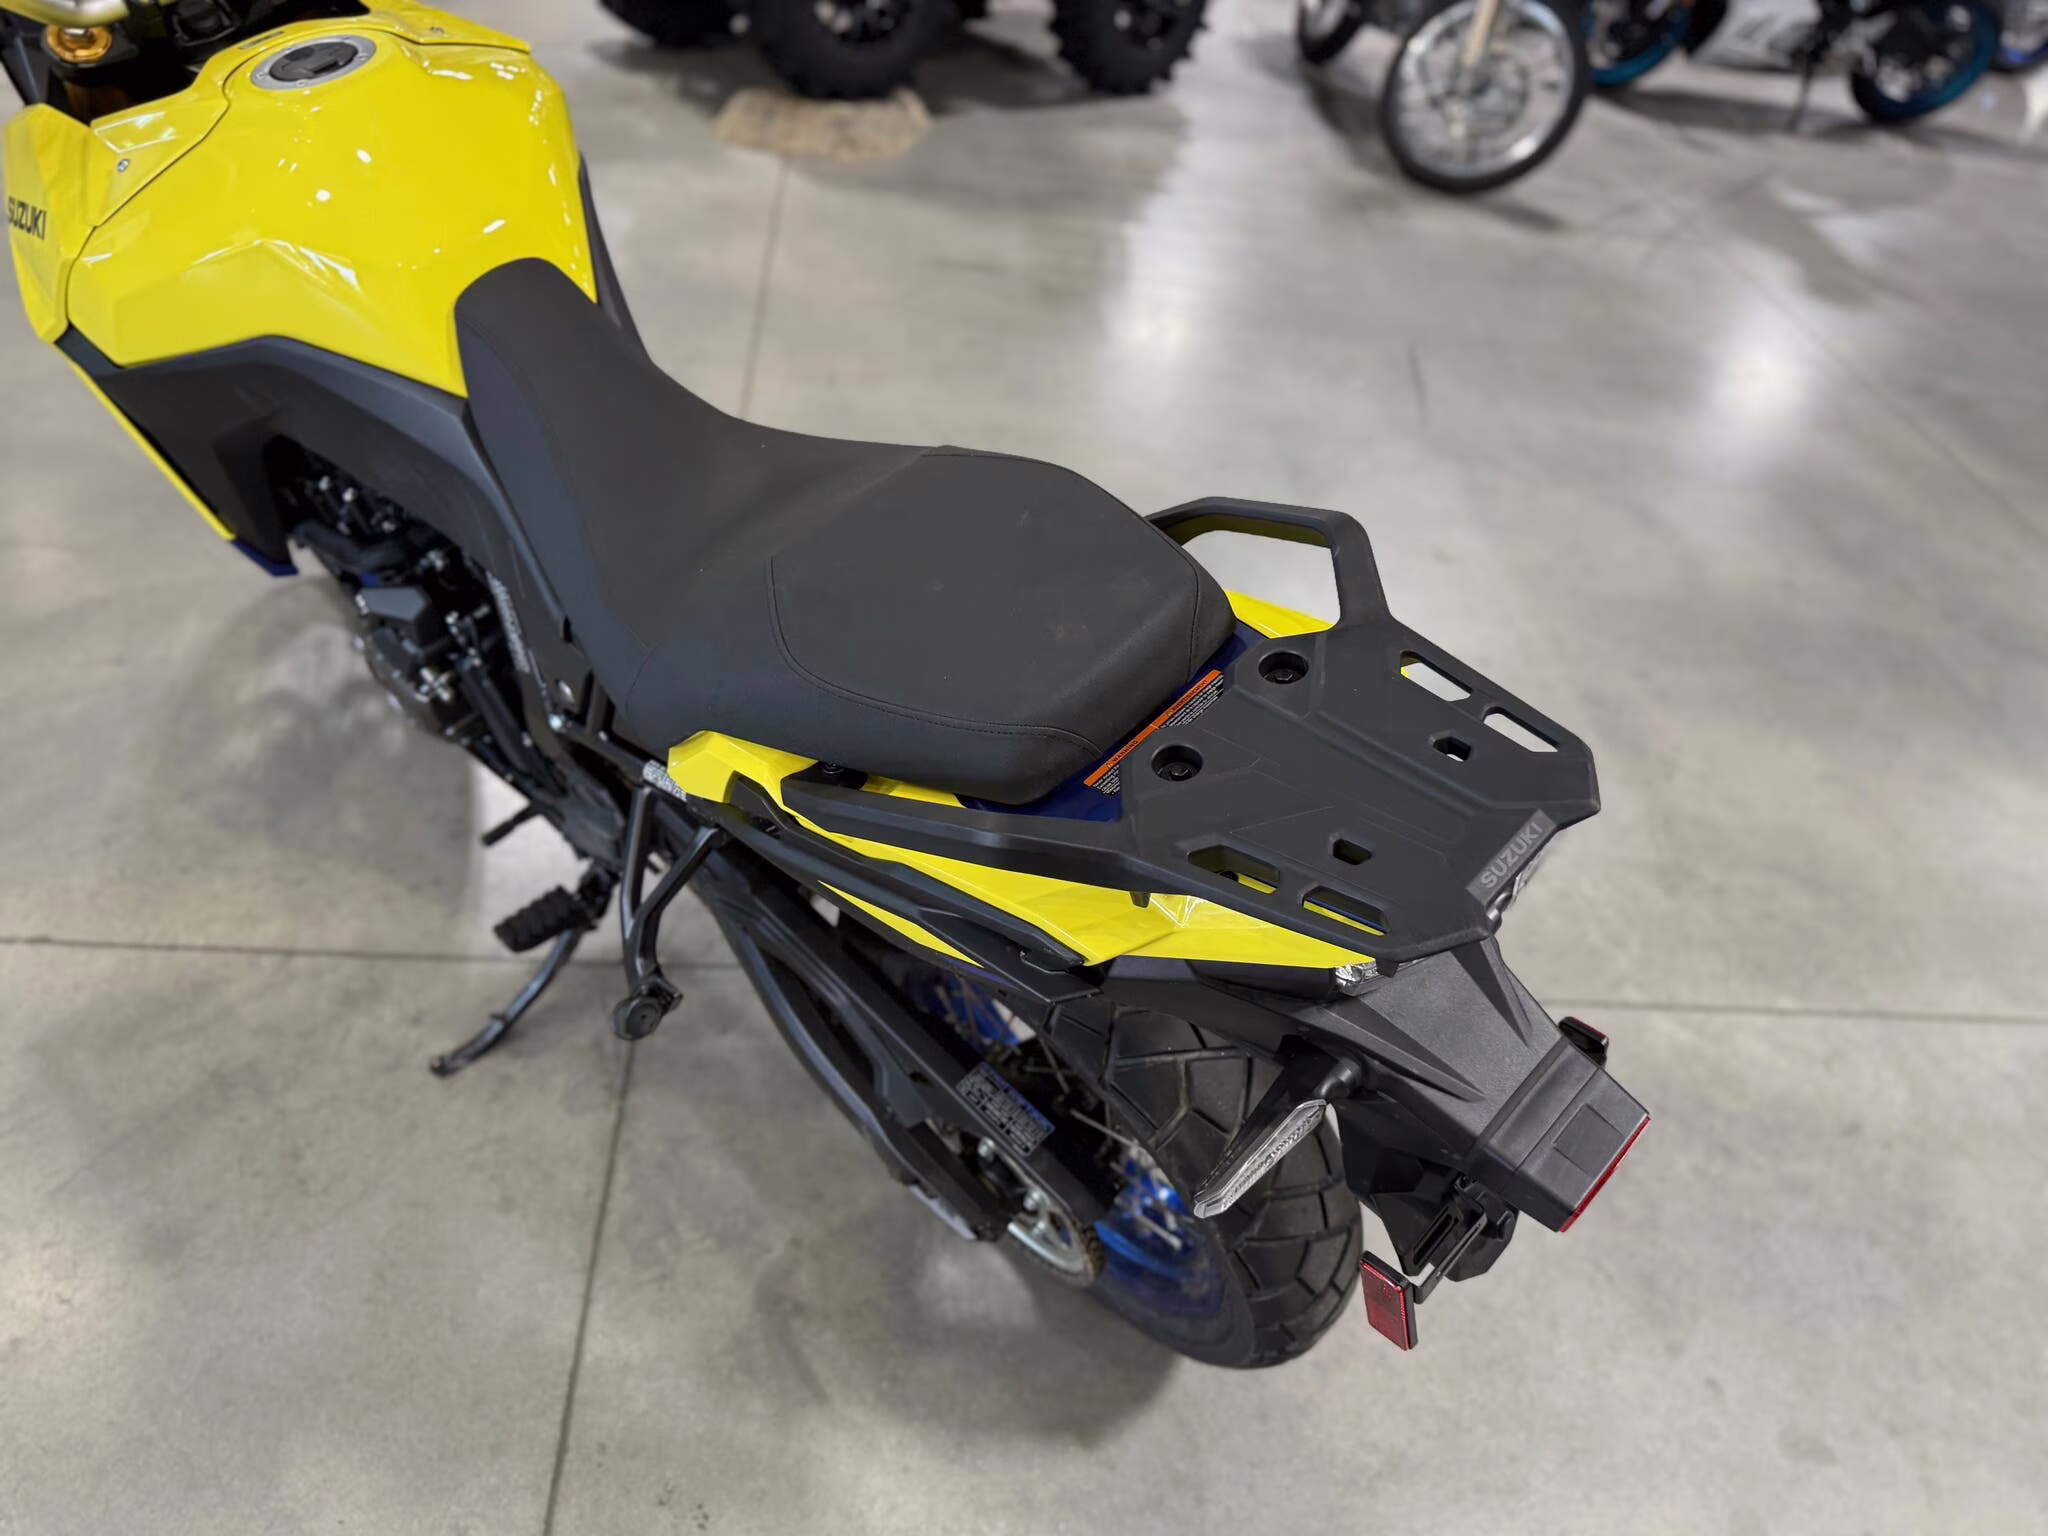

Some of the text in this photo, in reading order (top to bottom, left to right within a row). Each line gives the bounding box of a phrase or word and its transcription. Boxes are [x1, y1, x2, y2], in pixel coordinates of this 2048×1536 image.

[8, 196, 47, 240] SUZUKI
[1113, 739, 1139, 762] WARNING
[1480, 822, 1543, 888] SUZUKI
